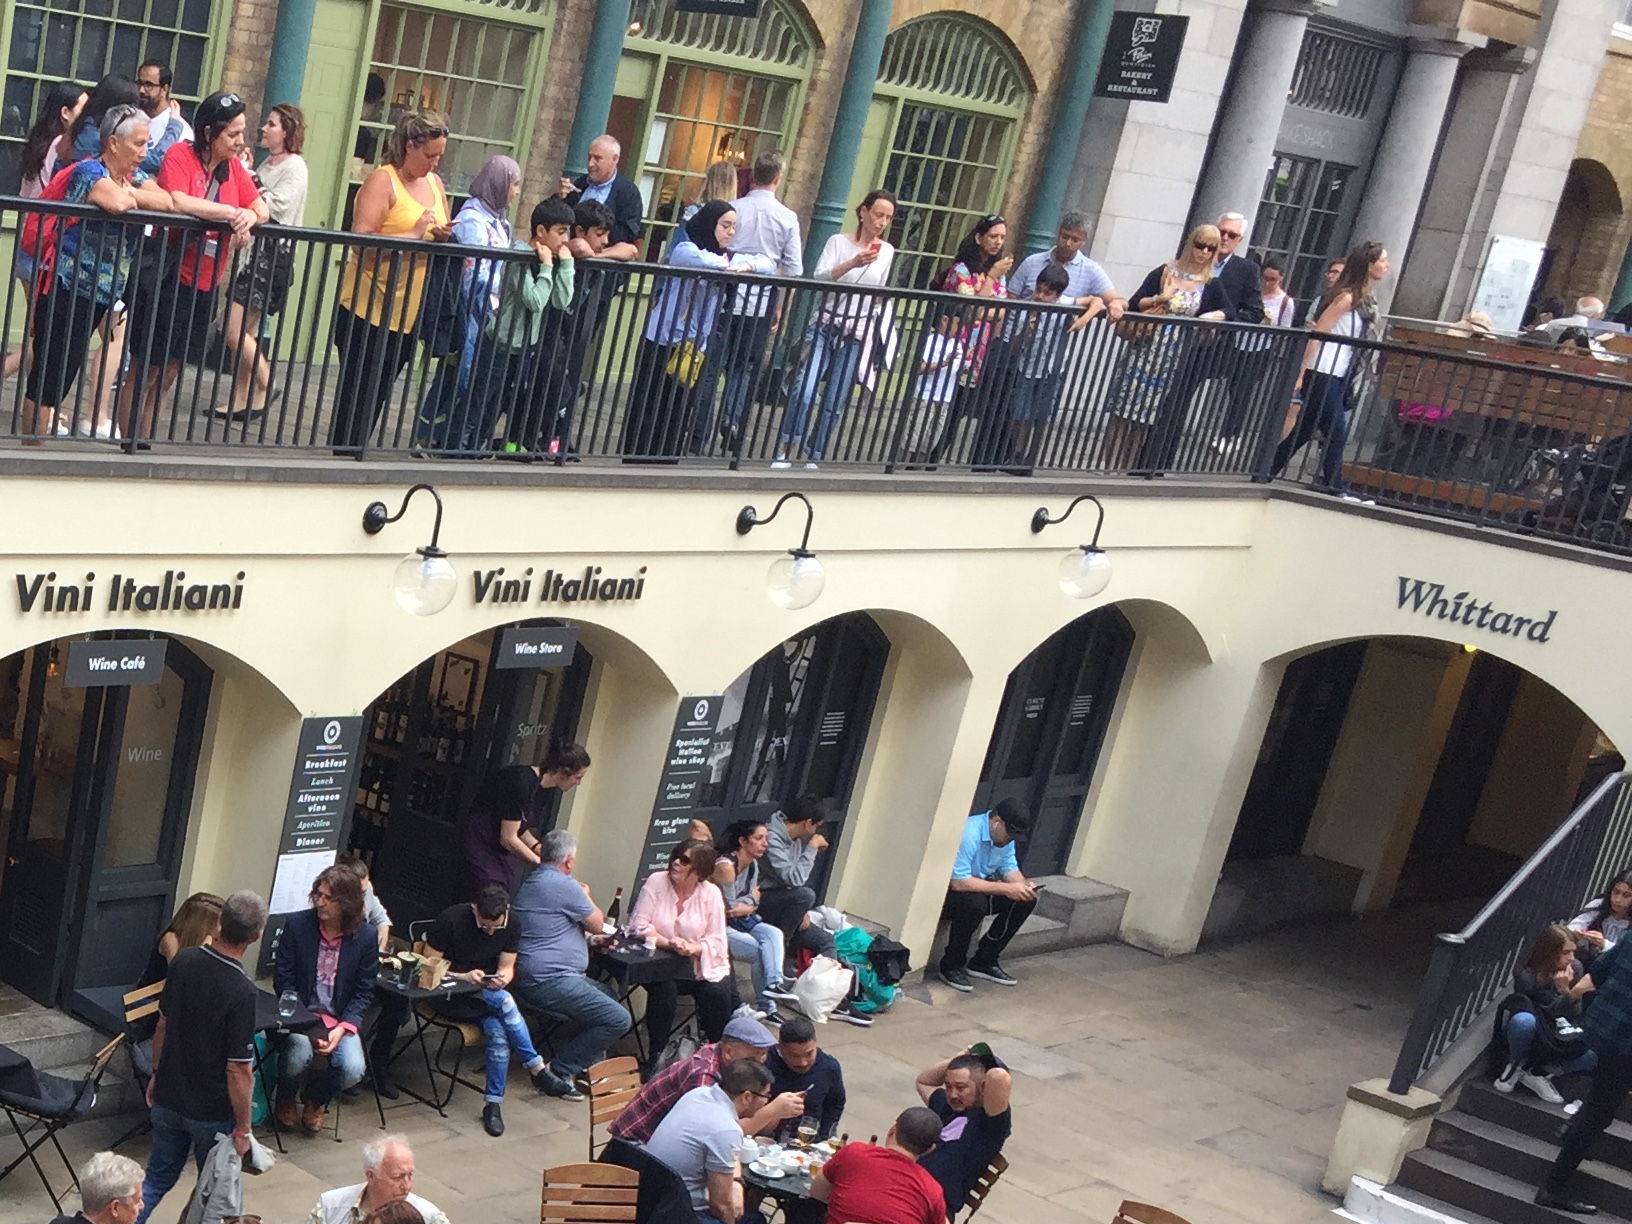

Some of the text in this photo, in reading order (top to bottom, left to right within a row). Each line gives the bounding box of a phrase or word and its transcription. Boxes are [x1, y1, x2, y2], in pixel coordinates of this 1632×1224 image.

[1120, 70, 1153, 79] BAKERY
[1107, 84, 1159, 95] RESTAURANT
[474, 566, 647, 603] Vini Italiani
[16, 570, 246, 612] Vini Italiani
[1398, 576, 1559, 643] Whittard
[515, 641, 563, 655] Wine Store
[88, 655, 146, 671] Wine Café
[128, 746, 162, 762] Wine
[305, 759, 347, 769] Breakfast
[671, 756, 706, 766] wine shop
[311, 776, 333, 786] Lunch
[297, 793, 340, 803] Afternoon
[308, 803, 326, 812] vino
[654, 819, 669, 827] Free
[296, 838, 325, 847] Dinner
